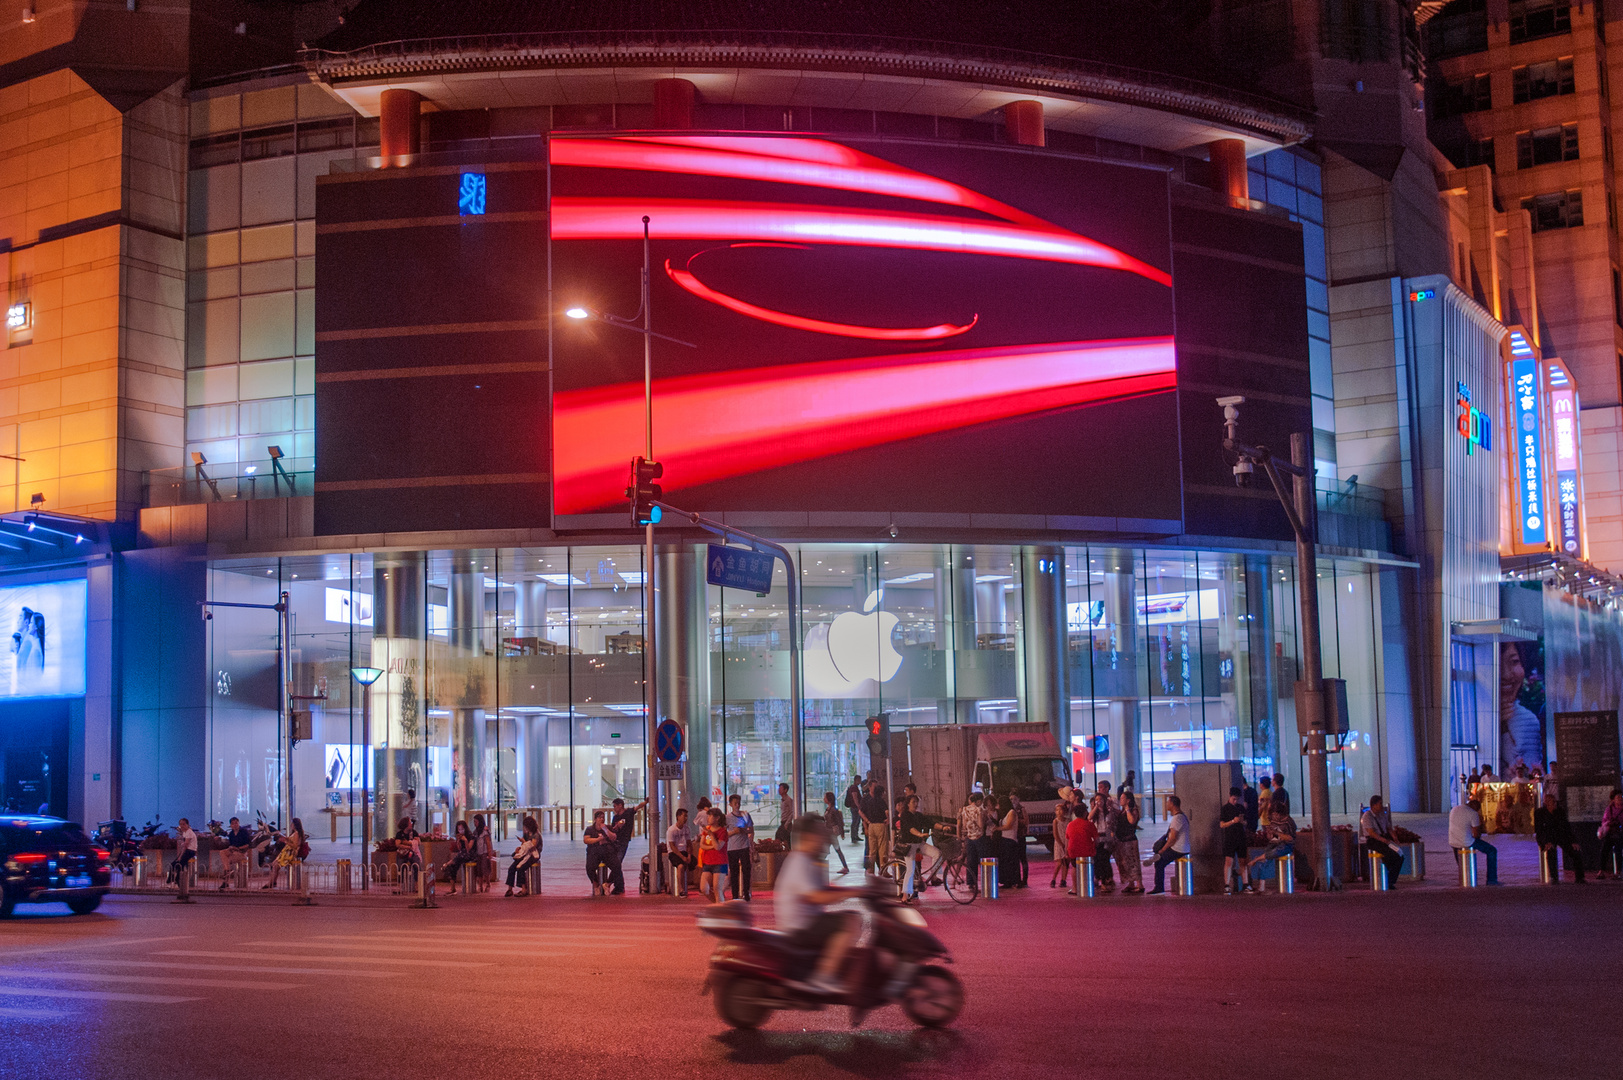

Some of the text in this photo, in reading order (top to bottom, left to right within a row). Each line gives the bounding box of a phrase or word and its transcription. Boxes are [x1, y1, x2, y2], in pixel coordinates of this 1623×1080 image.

[1410, 289, 1435, 302] apm
[1458, 399, 1491, 456] apm
[726, 554, 770, 575] 金鱼胡同
